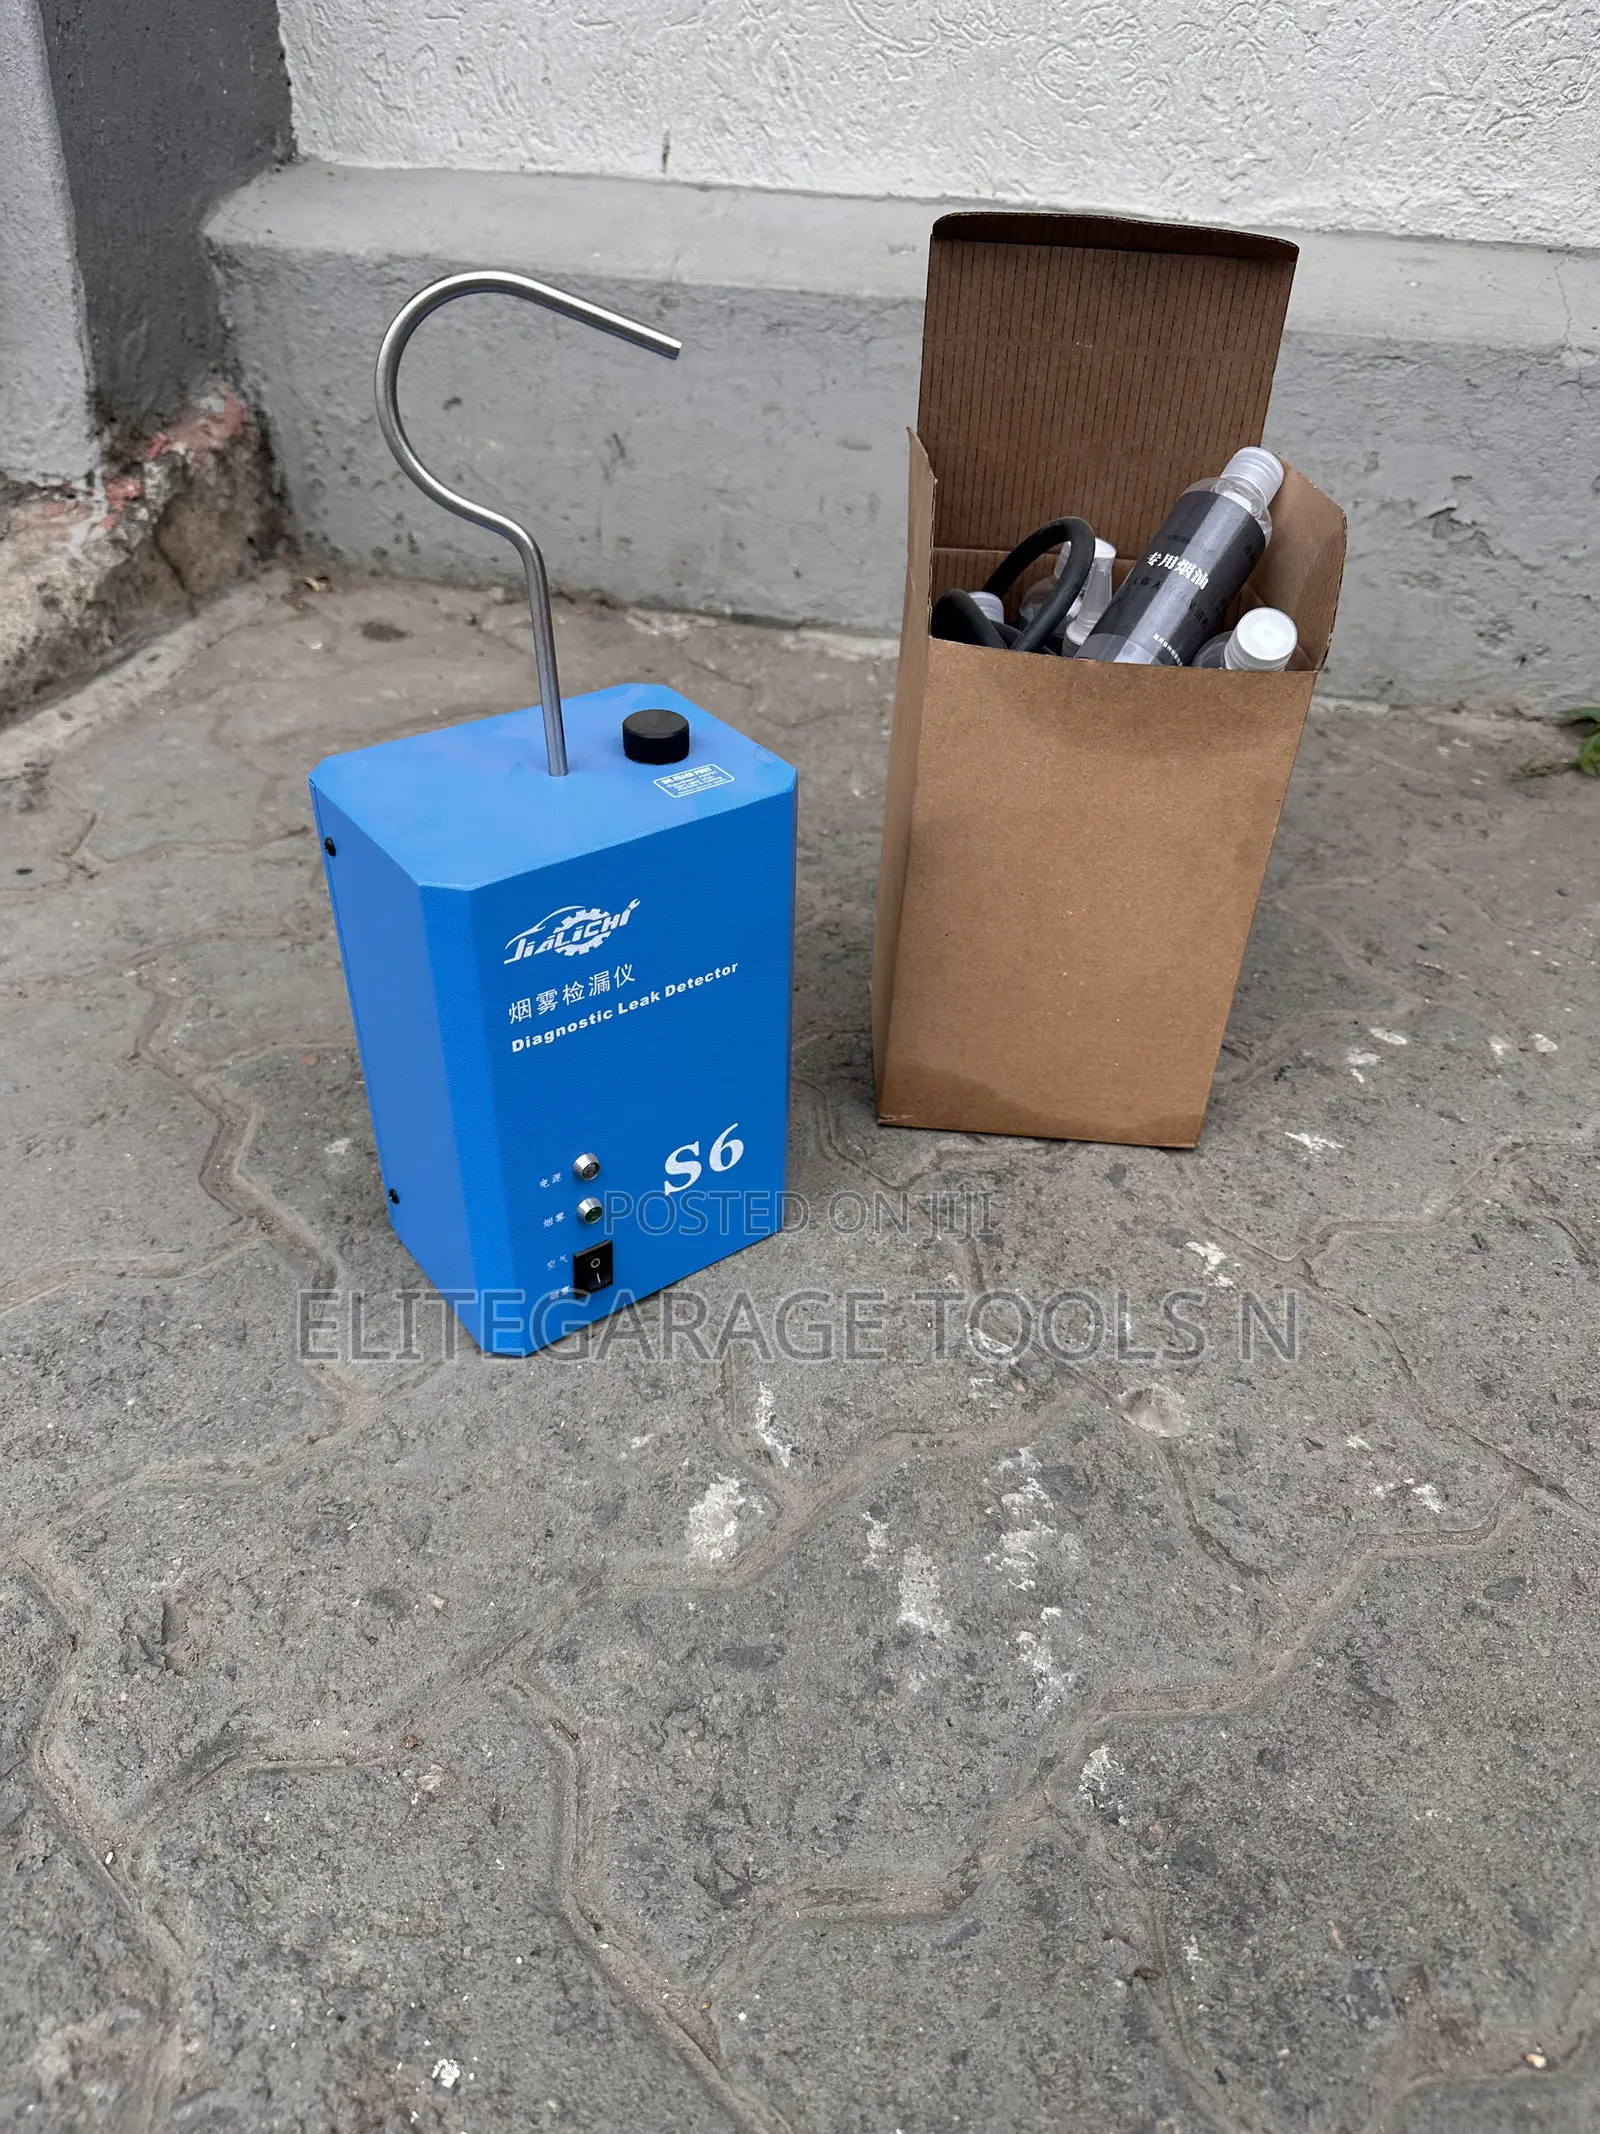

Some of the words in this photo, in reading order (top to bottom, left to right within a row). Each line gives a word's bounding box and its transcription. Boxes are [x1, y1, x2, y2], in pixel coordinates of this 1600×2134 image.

[1147, 552, 1209, 590] 专用烟油
[508, 963, 636, 1024] 烟雾检漏仪
[511, 1009, 614, 1053] Diagnostic
[618, 991, 660, 1015] Leak
[665, 962, 739, 998] Detector
[663, 1122, 745, 1196] S6
